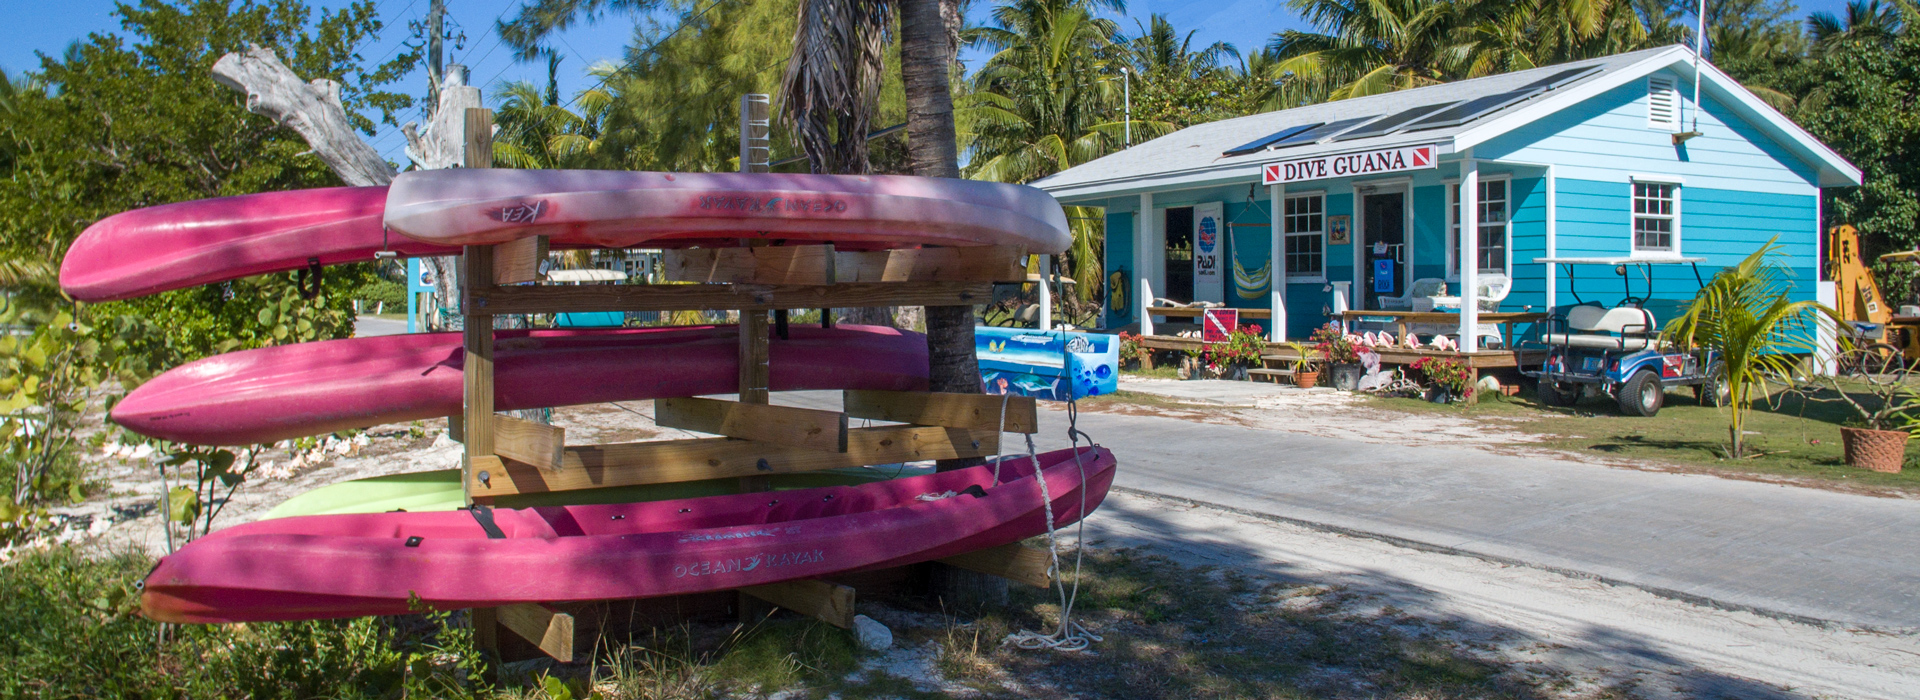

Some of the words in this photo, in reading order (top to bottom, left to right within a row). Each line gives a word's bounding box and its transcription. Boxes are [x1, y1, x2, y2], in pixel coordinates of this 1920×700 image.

[1283, 159, 1327, 181] DIVE
[1333, 150, 1407, 175] GUANA
[502, 201, 541, 224] KEA
[699, 196, 760, 212] KAYAK
[785, 198, 848, 213] OCEAN
[1197, 255, 1216, 269] PADI
[673, 558, 741, 578] OCEAN
[766, 549, 825, 568] KAYAK
